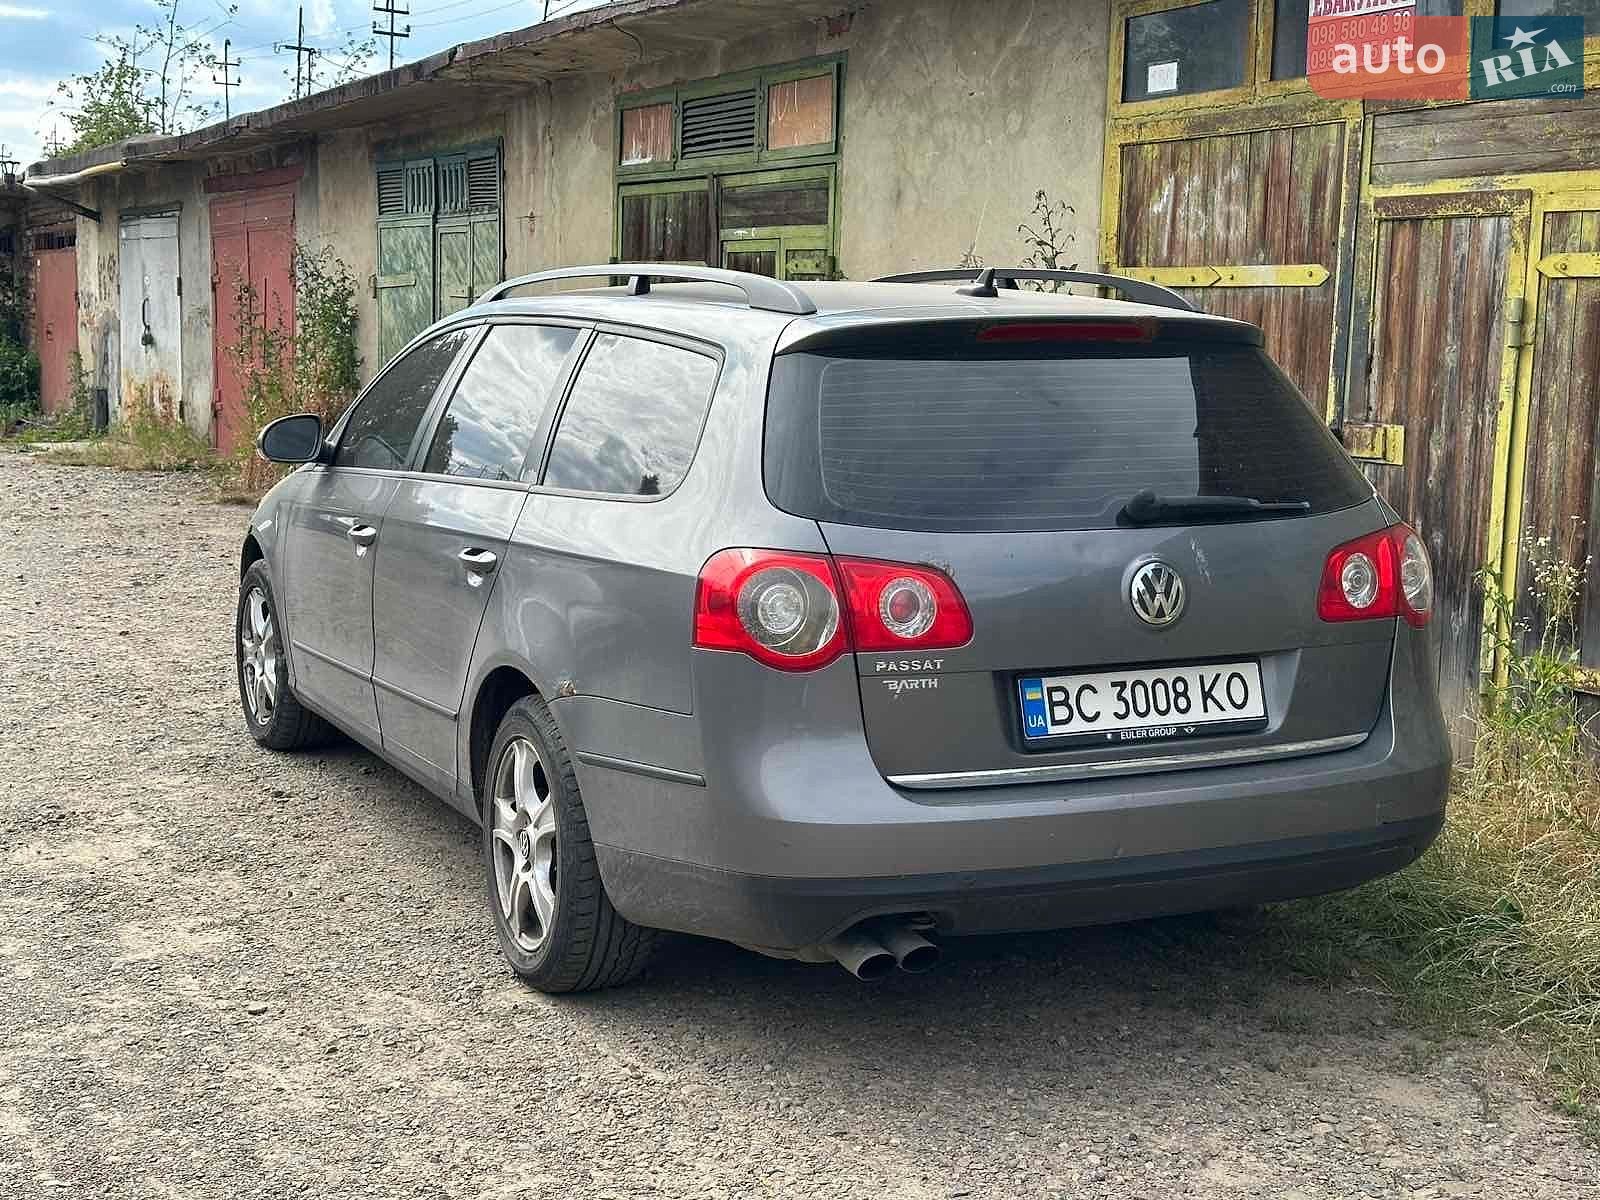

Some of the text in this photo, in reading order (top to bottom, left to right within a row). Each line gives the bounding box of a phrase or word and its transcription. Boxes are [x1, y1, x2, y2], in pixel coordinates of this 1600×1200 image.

[1312, 11, 1411, 46] 098 580 48 98
[875, 659, 944, 672] PASSAT
[1047, 672, 1249, 727] BC 3008 KO
[1028, 713, 1046, 729] UA
[1120, 727, 1177, 740] EULER GROUP
